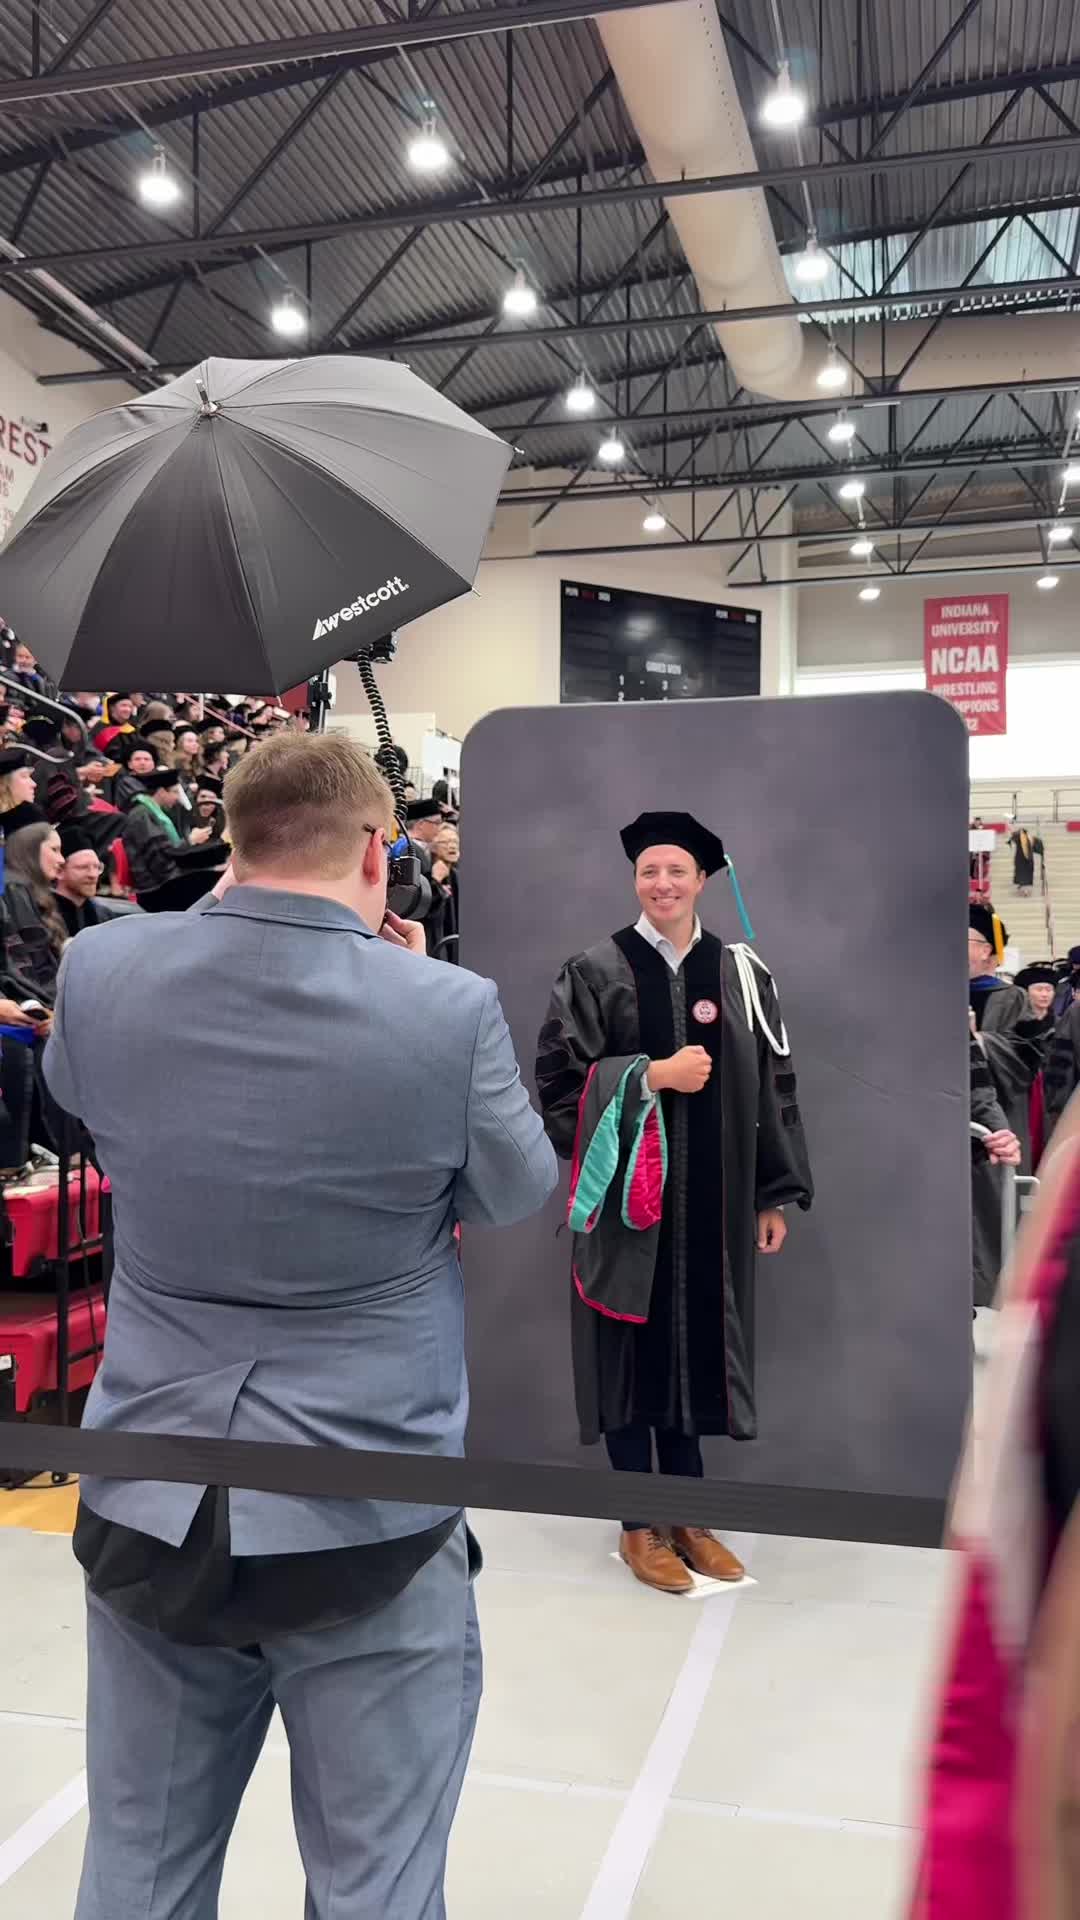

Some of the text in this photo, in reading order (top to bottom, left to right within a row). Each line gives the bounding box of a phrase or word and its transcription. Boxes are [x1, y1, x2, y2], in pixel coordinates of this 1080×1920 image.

[942, 603, 989, 619] INDIANA
[931, 621, 1000, 637] UNIVERSITY
[931, 645, 1000, 676] NCAA
[932, 681, 997, 697] WRESTLING
[953, 699, 1000, 713] MPIONS
